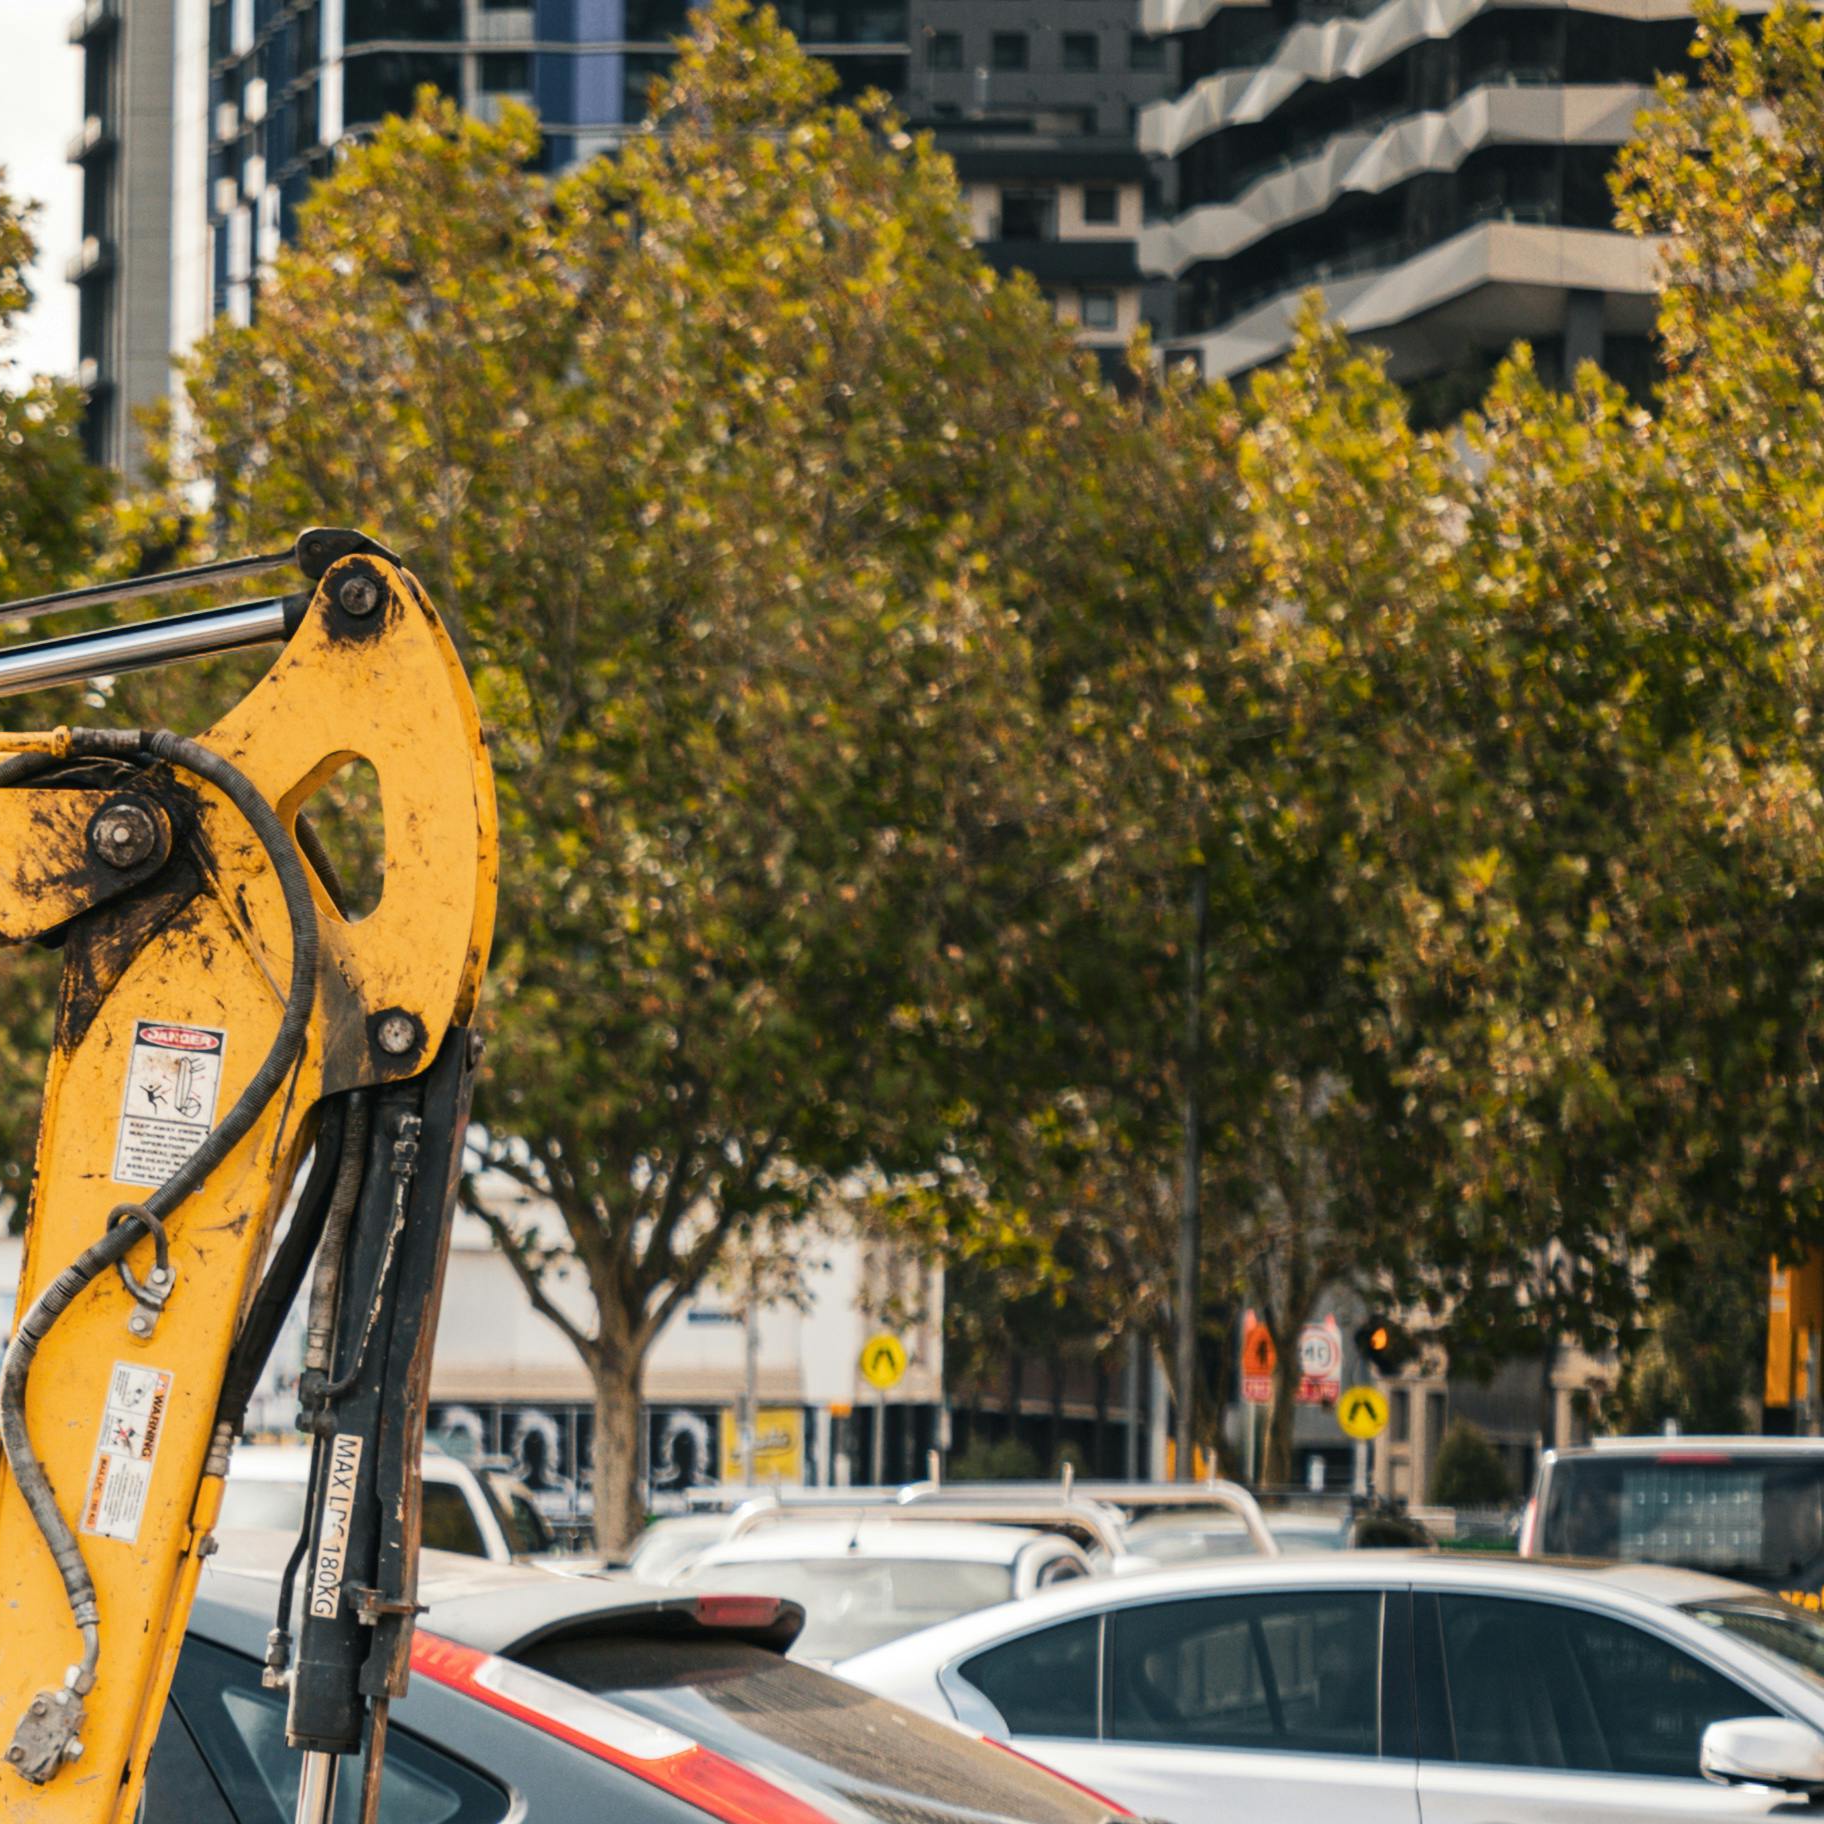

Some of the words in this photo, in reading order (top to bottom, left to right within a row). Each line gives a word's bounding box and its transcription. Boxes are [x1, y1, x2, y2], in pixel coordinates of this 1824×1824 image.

[125, 1147, 168, 1158] PERSONAL
[129, 1130, 166, 1140] MACHINE
[168, 1136, 200, 1144] DURING
[140, 1140, 187, 1150] OPERATION
[141, 1396, 164, 1457] WARNING
[332, 1437, 358, 1491] MAX
[314, 1546, 340, 1615] 180KG
